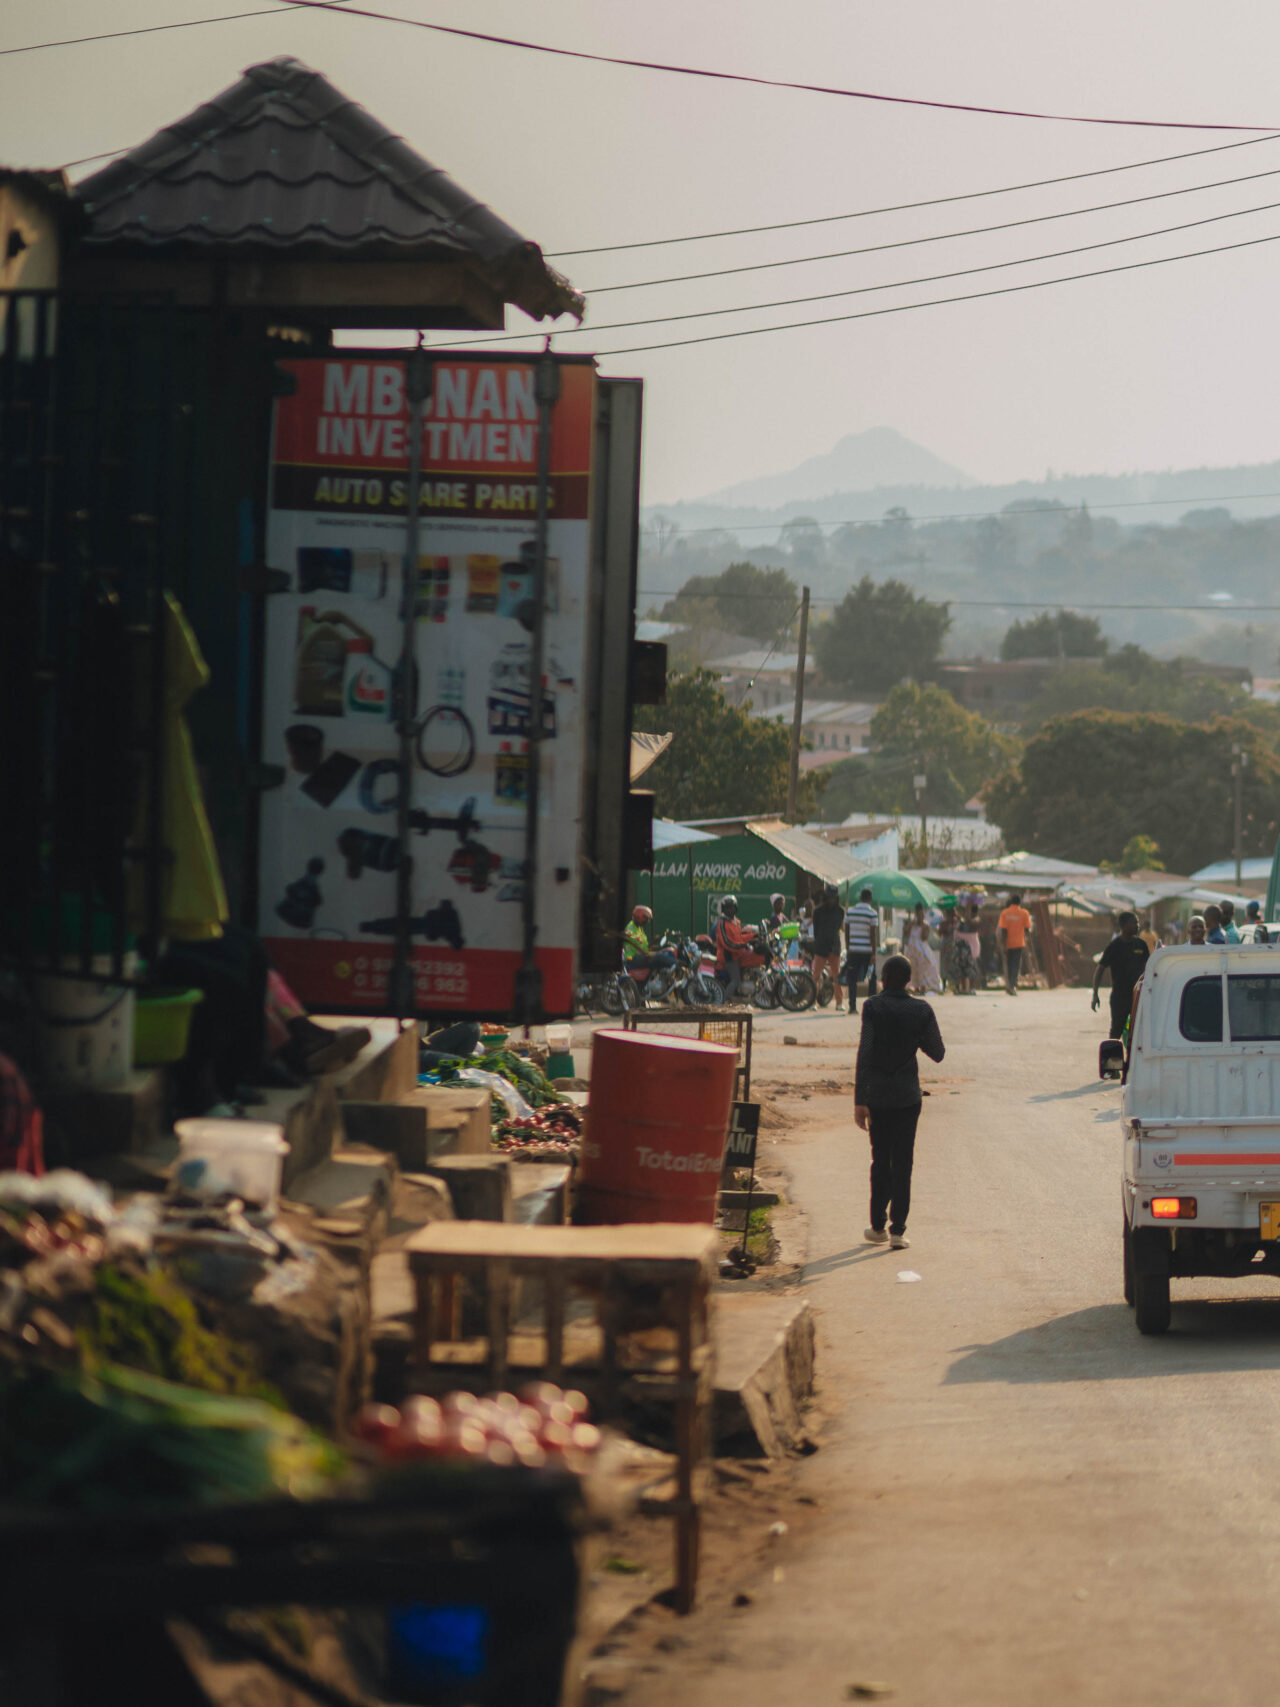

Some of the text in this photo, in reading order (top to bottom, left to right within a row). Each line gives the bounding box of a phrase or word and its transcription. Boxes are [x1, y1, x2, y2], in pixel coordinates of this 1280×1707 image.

[323, 363, 538, 420] MBNAN
[317, 416, 551, 462] INVETMEN
[315, 477, 382, 504] AUTO
[390, 481, 467, 508] SARE
[692, 863, 741, 878] KNOWS
[744, 862, 786, 880] AGRO
